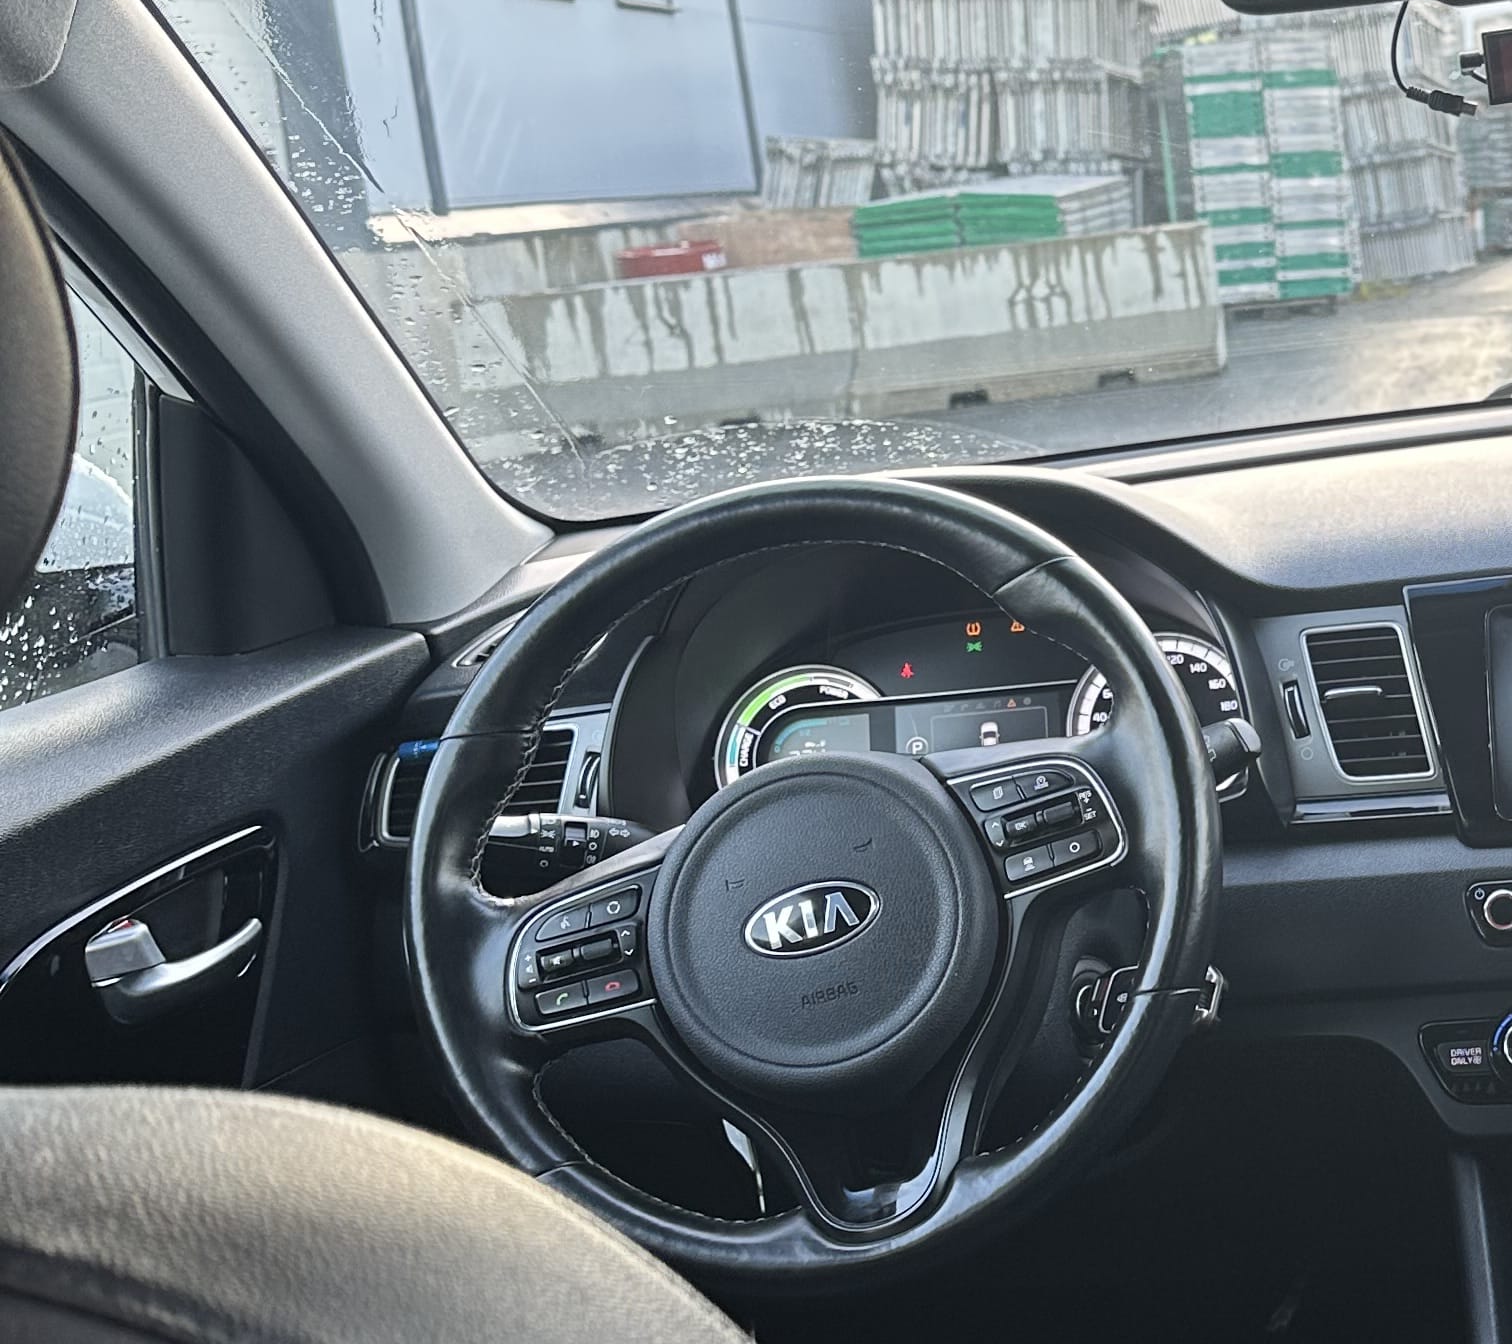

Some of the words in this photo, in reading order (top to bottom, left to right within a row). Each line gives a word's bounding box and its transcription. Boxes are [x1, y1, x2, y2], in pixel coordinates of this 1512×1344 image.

[1166, 654, 1185, 666] 20
[1190, 662, 1208, 673] 140
[1208, 678, 1226, 690] 160
[1092, 712, 1108, 722] 40
[912, 741, 924, 755] P
[762, 891, 860, 950] KIA
[801, 982, 859, 1008] AIRBAG
[1450, 1047, 1482, 1057] DRIVER
